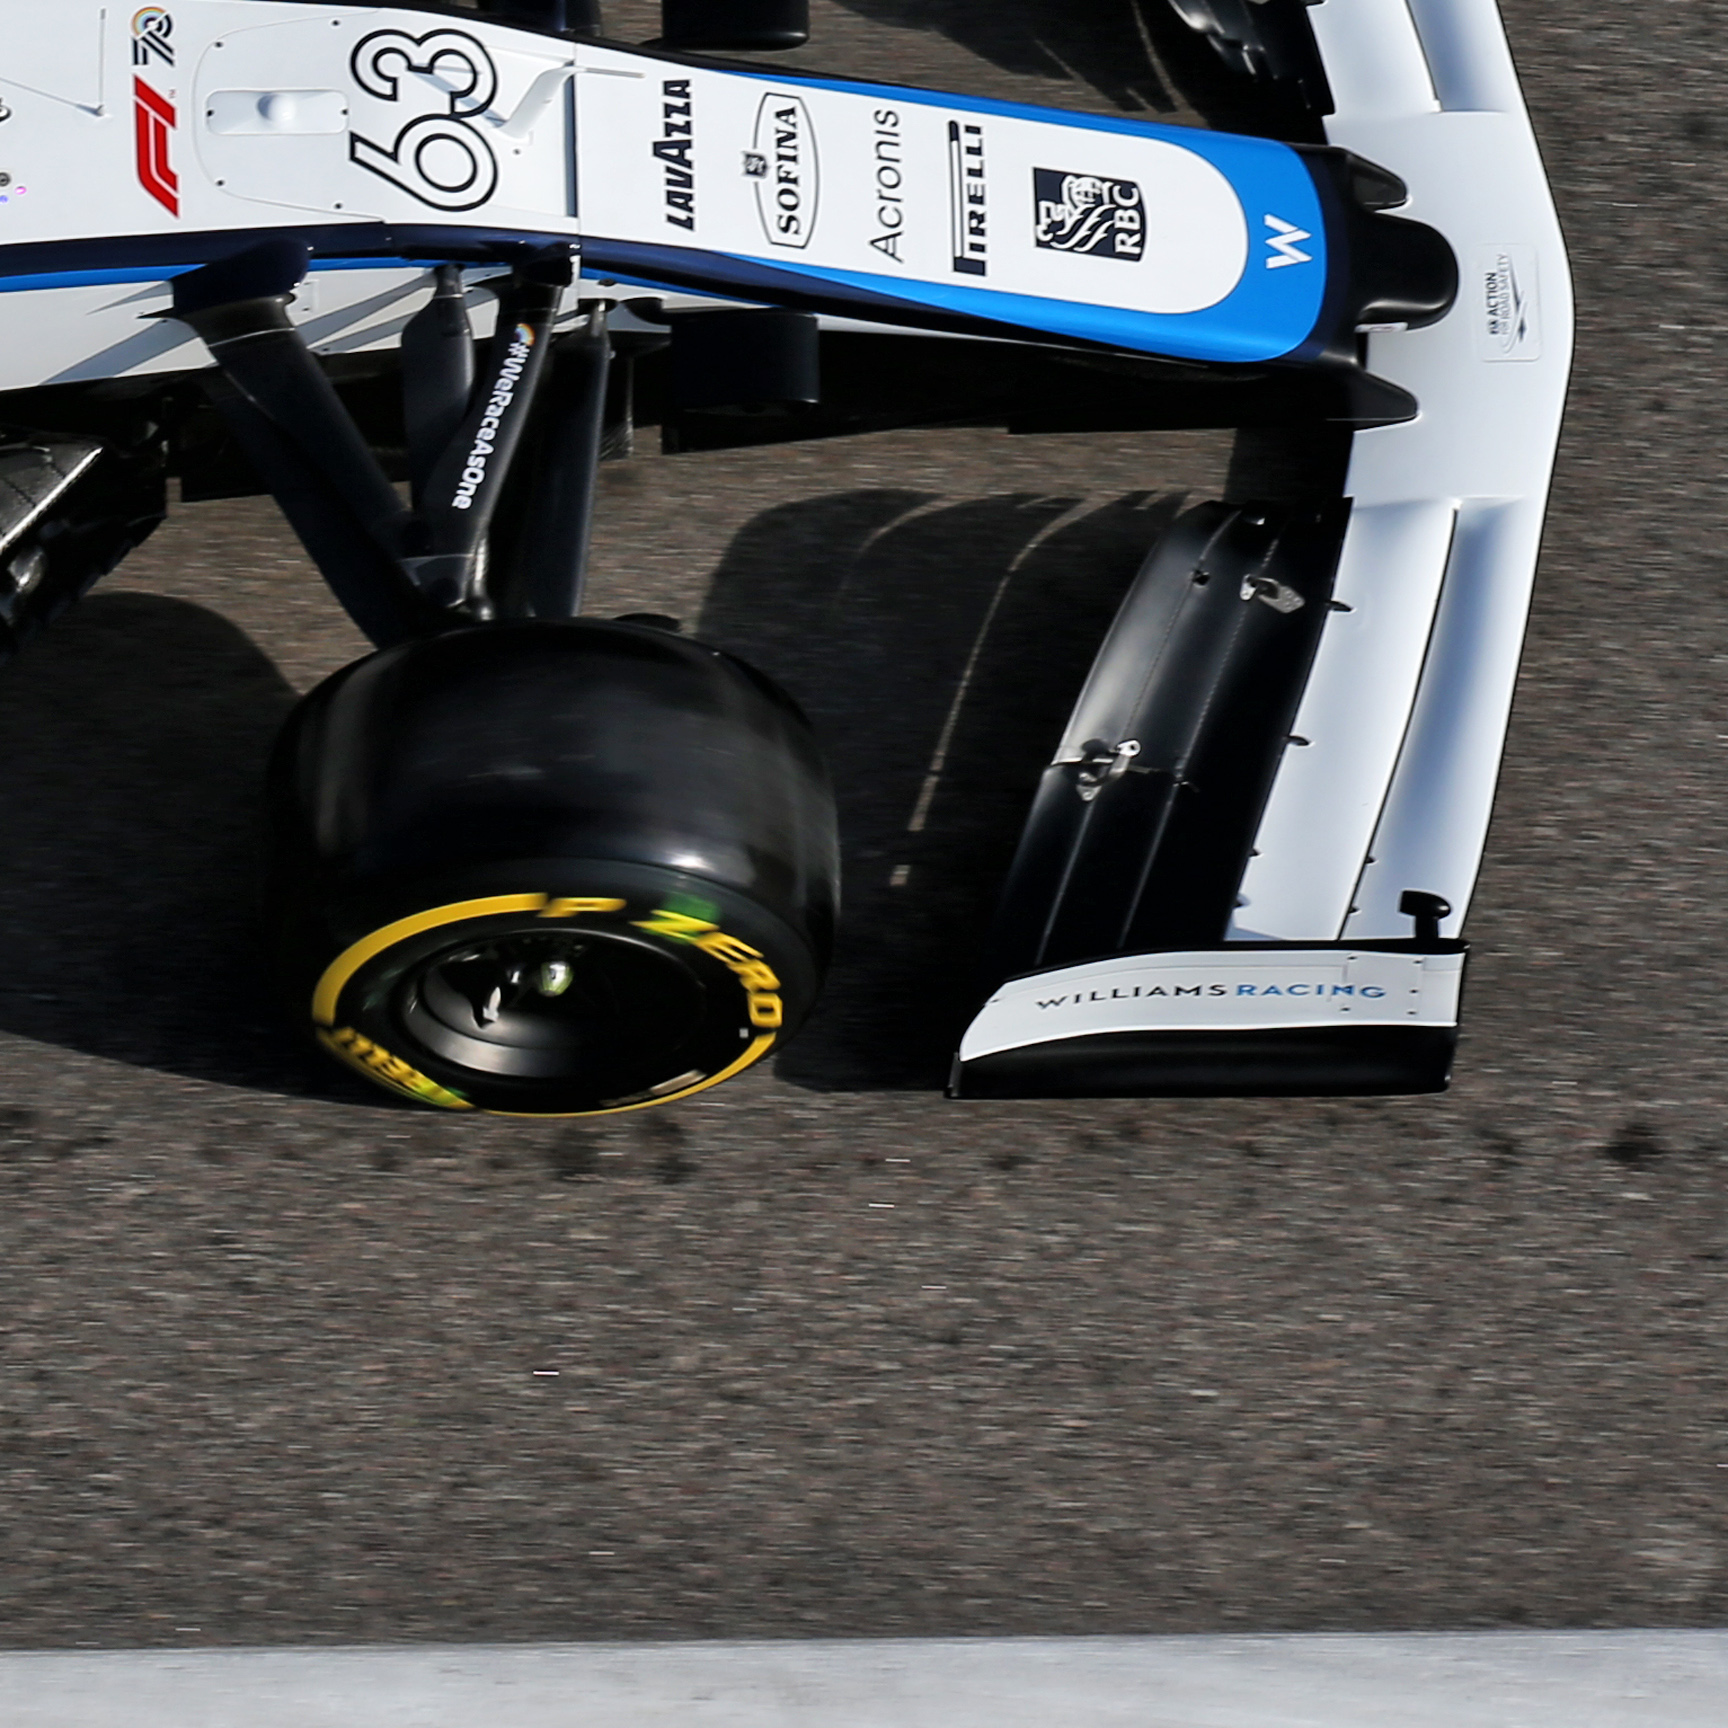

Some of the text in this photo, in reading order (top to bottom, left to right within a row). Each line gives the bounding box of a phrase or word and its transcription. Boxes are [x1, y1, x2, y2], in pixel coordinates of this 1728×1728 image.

[349, 28, 499, 212] 63
[652, 79, 695, 232] LAVAZZA
[775, 106, 801, 235] SOFINA
[869, 109, 904, 264] Acronis
[948, 120, 987, 275] PIRELLI
[1113, 183, 1142, 255] RBC
[1263, 214, 1312, 268] W
[1485, 272, 1499, 316] ACTION
[451, 342, 530, 510] #WeRaceAsOne
[628, 908, 783, 1028] ZERO
[1036, 983, 1387, 1010] WILLIAMS RACING
